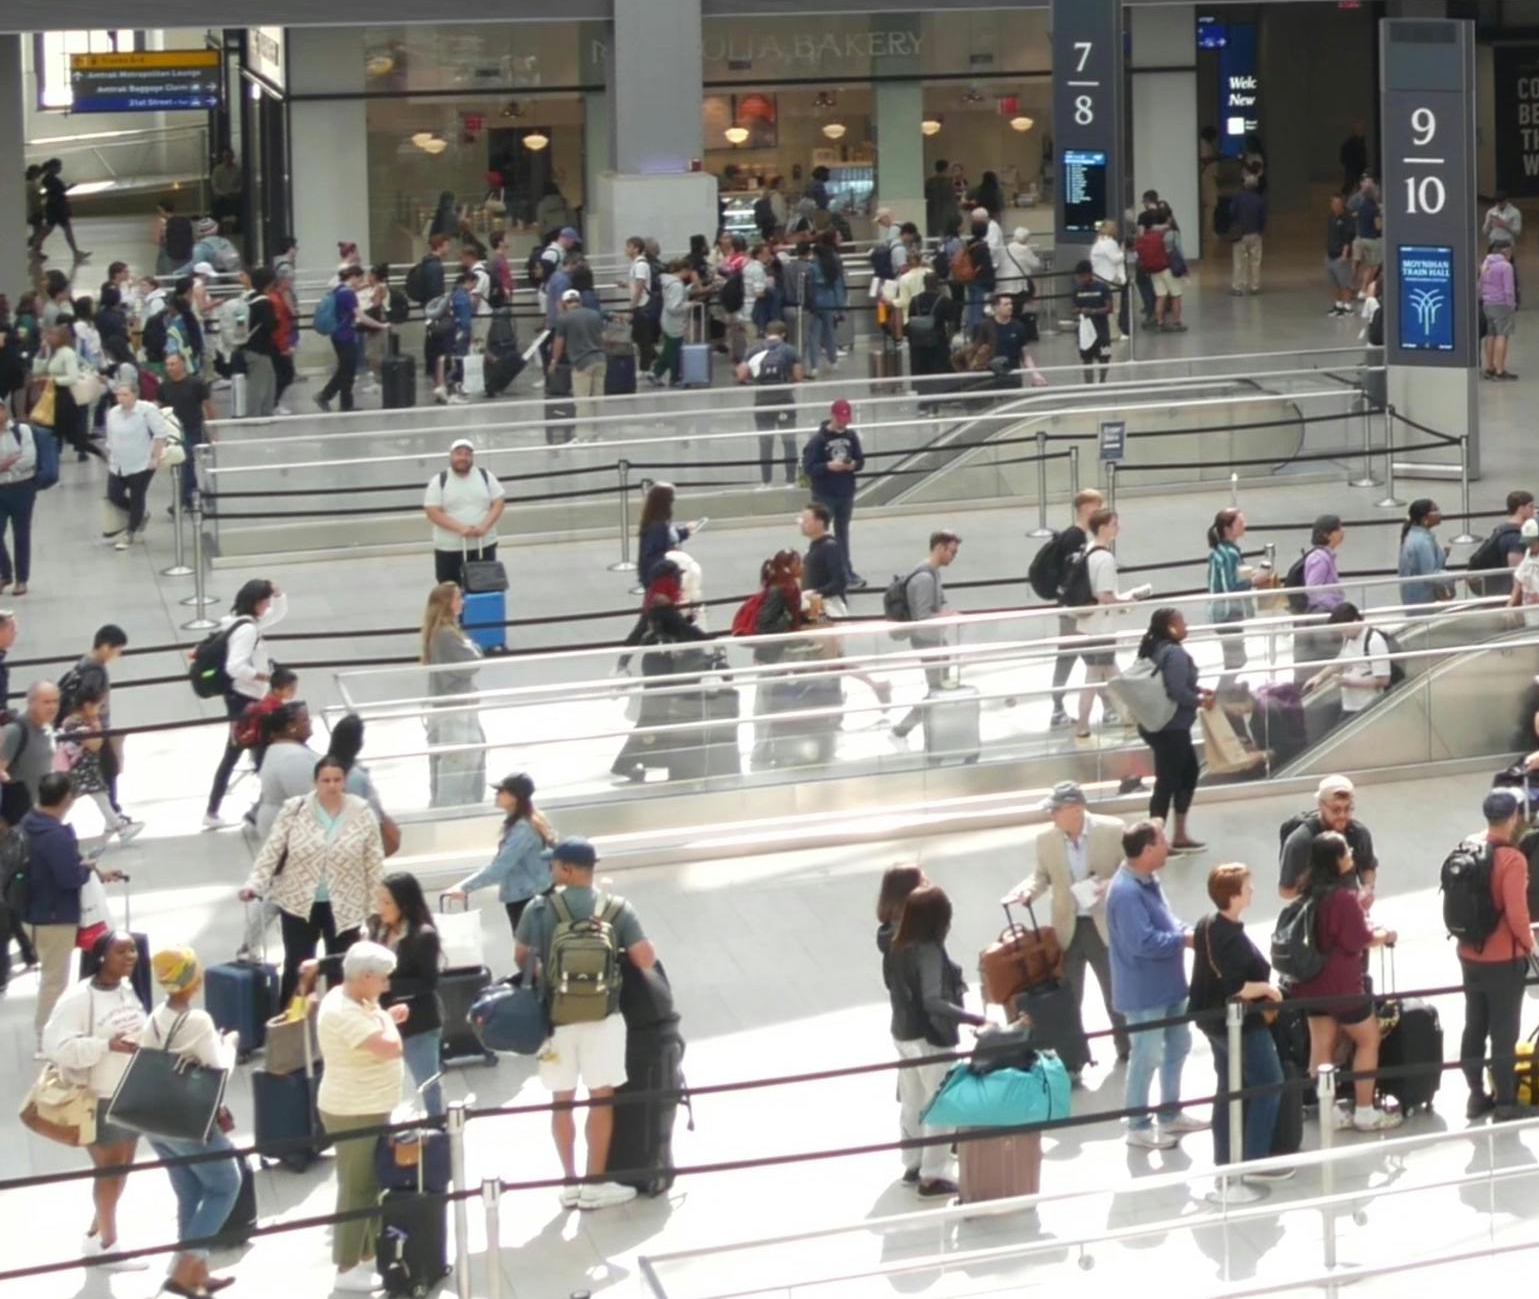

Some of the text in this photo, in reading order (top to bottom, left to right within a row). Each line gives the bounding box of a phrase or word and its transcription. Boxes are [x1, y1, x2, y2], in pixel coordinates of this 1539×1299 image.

[1075, 42, 1091, 71] 7
[1075, 96, 1092, 124] 8
[1229, 93, 1255, 106] New
[1412, 108, 1435, 145] 9
[1407, 177, 1445, 213] 10
